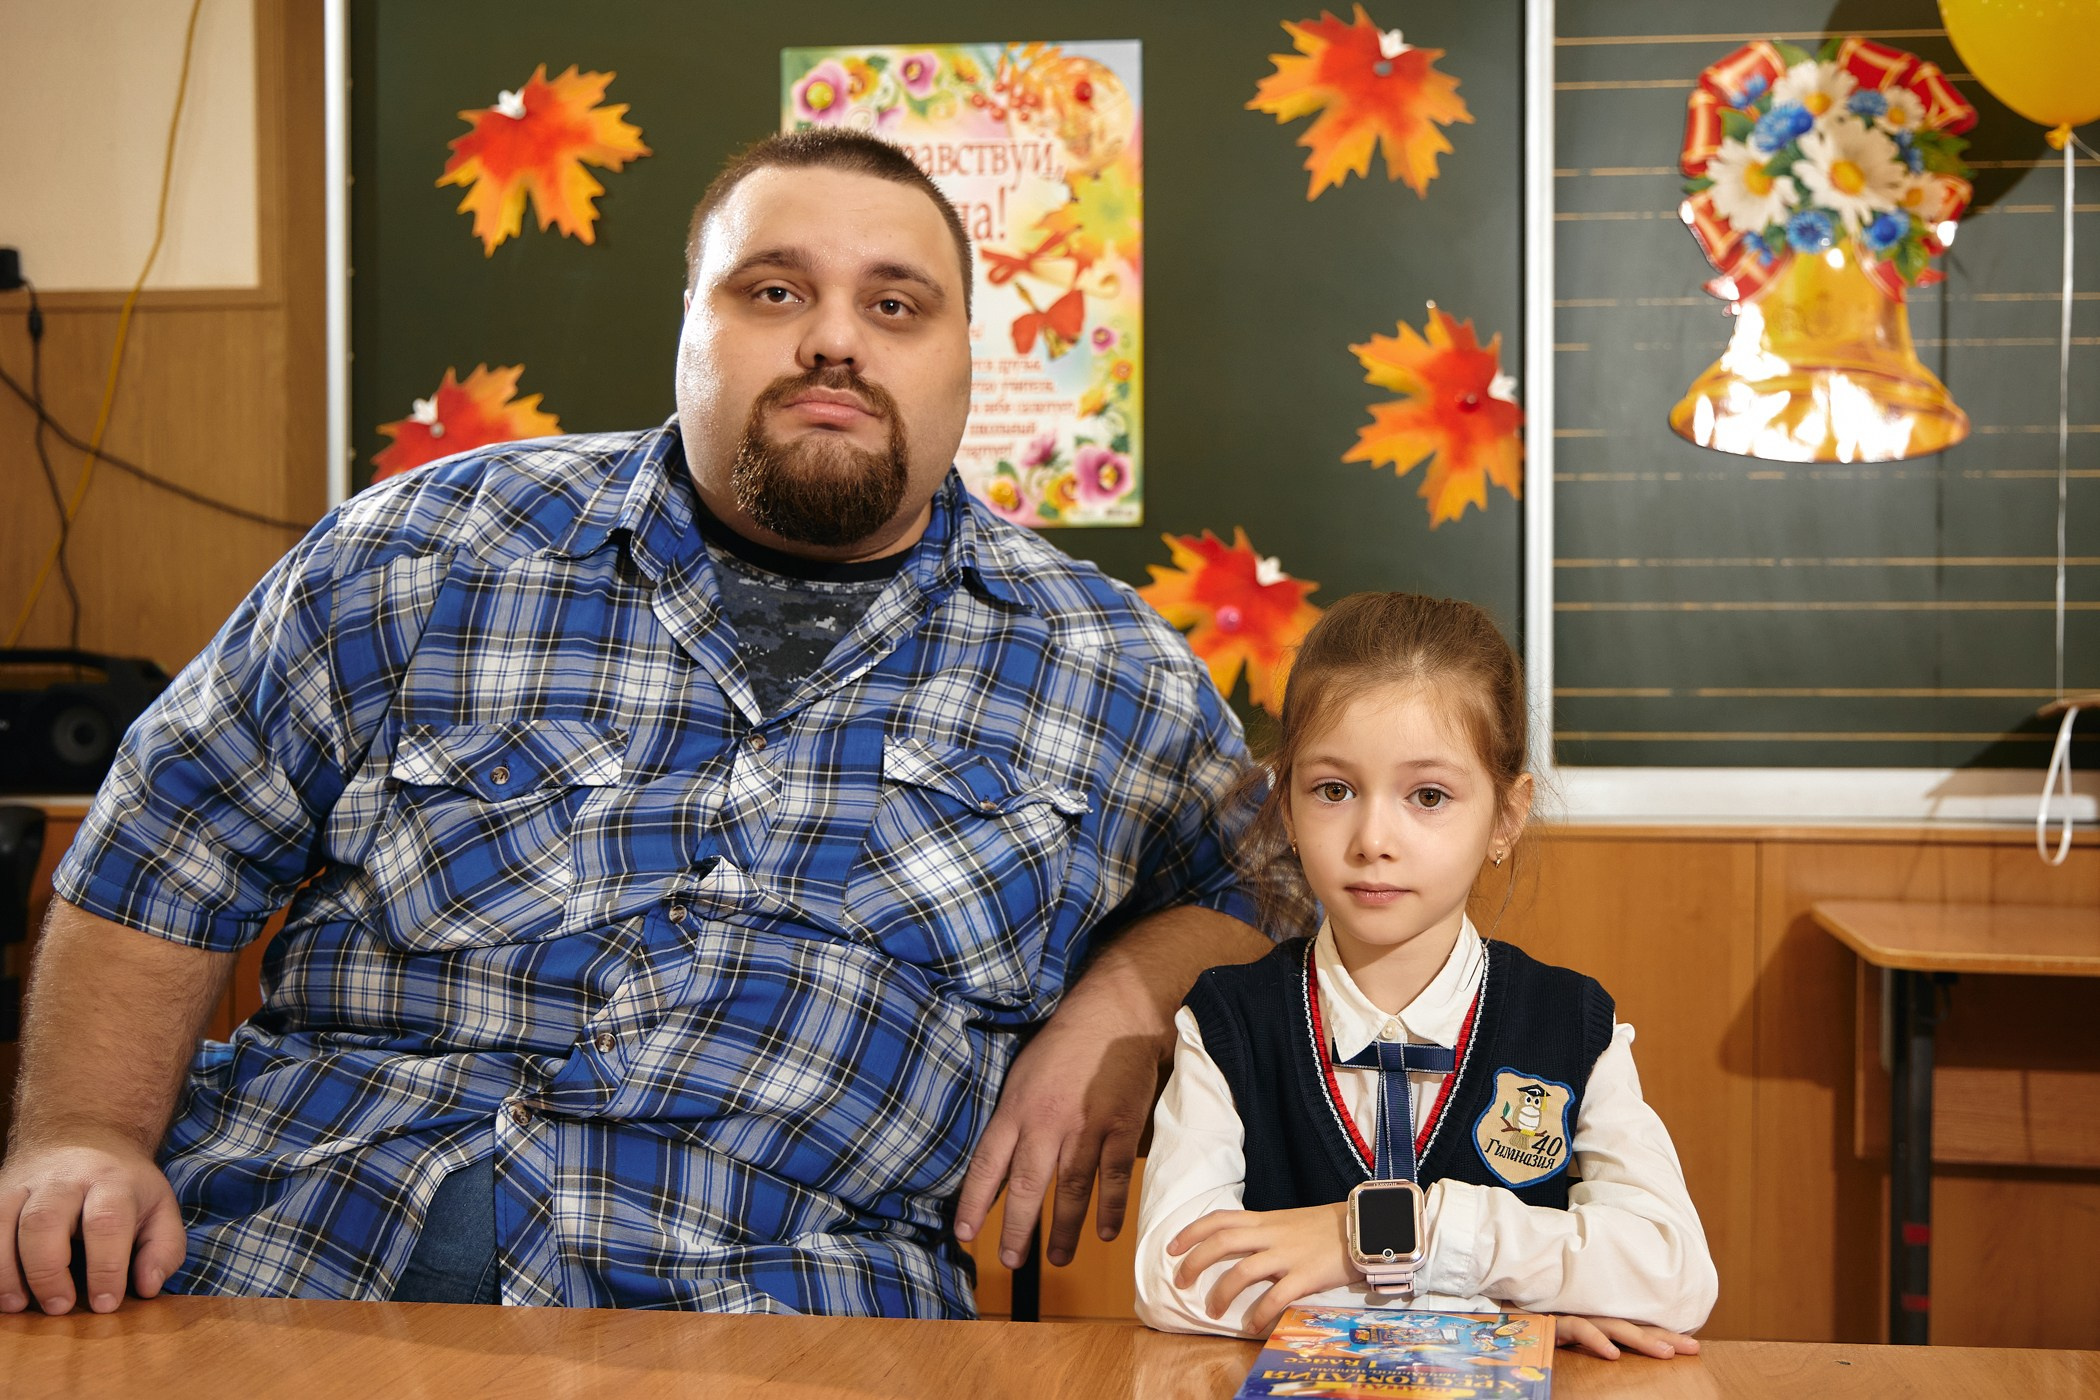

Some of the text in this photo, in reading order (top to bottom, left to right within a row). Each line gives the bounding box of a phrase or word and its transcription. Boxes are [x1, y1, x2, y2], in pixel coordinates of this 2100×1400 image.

[1485, 1138, 1556, 1170] Гимназия
[1531, 1135, 1563, 1157] 40
[1262, 1369, 1521, 1394] ХРЕСТОМАТИЯ
